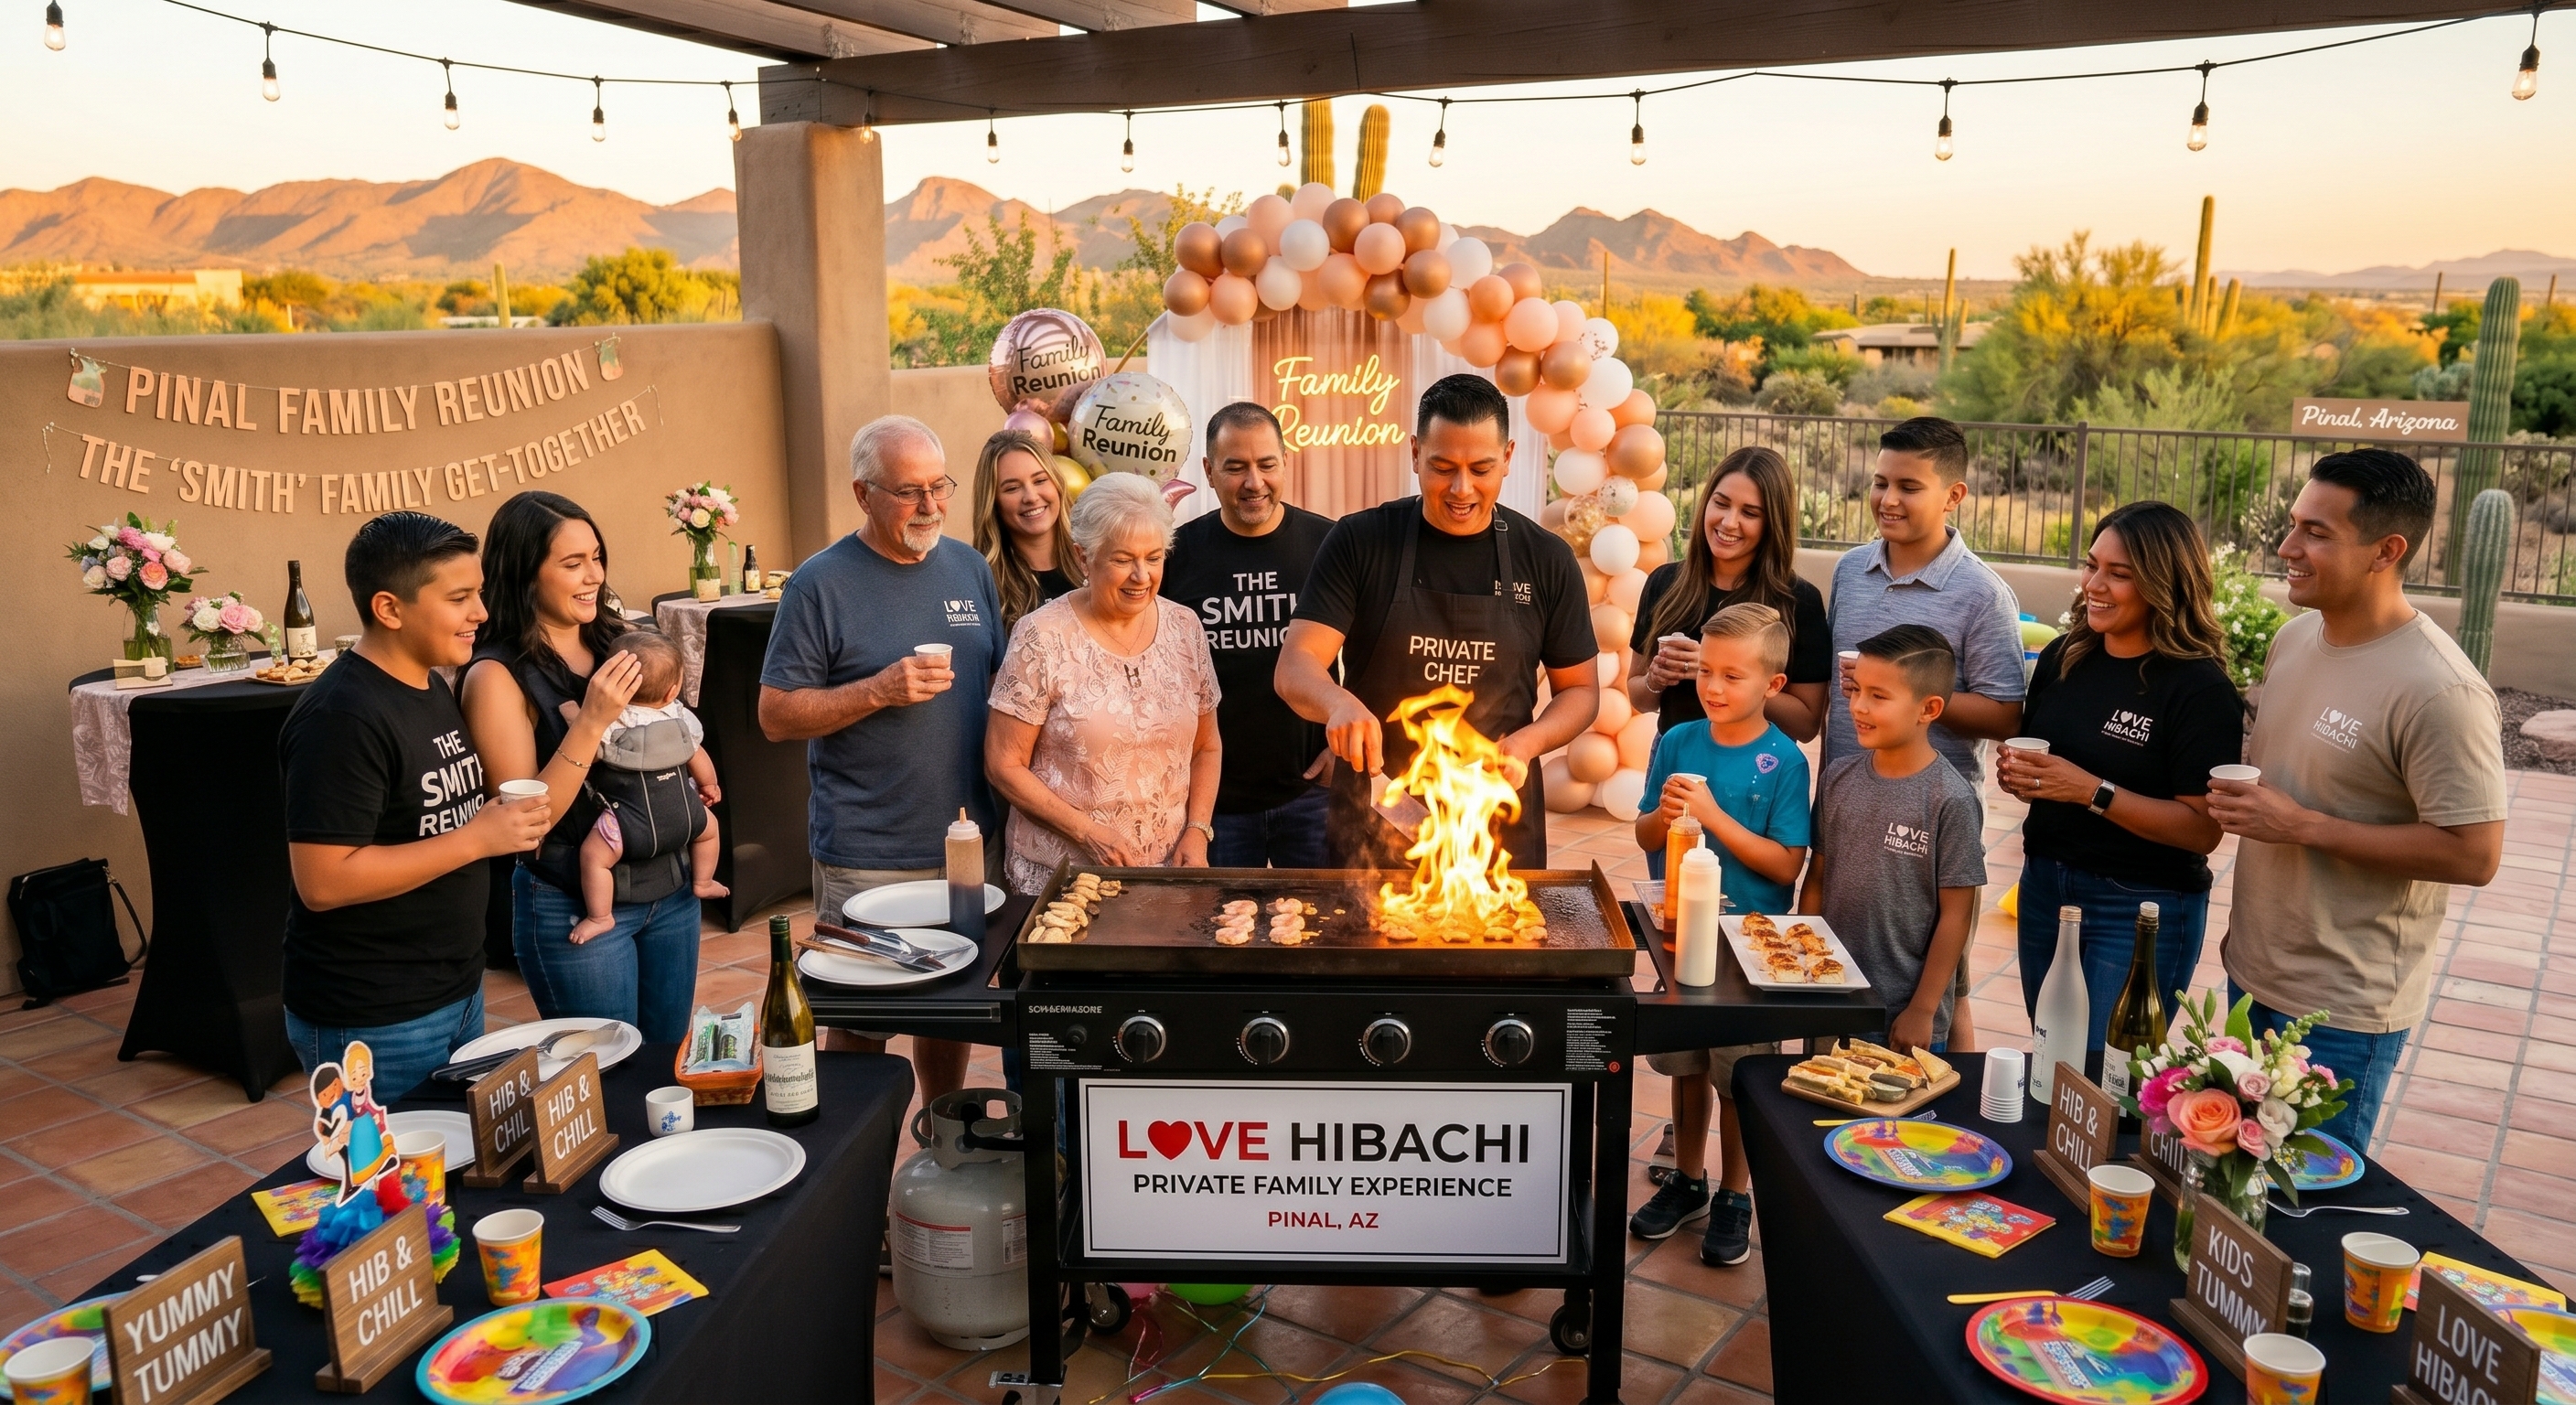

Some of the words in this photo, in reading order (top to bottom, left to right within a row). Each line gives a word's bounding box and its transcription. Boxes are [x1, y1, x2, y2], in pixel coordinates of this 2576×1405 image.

[1017, 335, 1089, 372] Family
[125, 366, 257, 432] PINAL
[278, 384, 419, 434] FAMILY
[435, 349, 591, 426] REUNION
[1013, 365, 1101, 395] Reunion
[1273, 354, 1401, 415] Family
[1082, 428, 1177, 462] Reunion
[1094, 404, 1174, 445] Family
[1271, 403, 1406, 453] Reunion
[2302, 405, 2363, 428] Pinal,
[2369, 408, 2459, 435] Arizona
[79, 434, 156, 494] THE
[321, 467, 433, 514] FAMILY
[445, 400, 647, 501] GET-TOGETHER
[1232, 572, 1278, 592] THE
[1205, 627, 1289, 649] REUNI
[1409, 636, 1496, 660] PRIVATE
[1424, 661, 1480, 684] CHEF
[433, 729, 466, 759] THE
[489, 1080, 516, 1120] HIB
[520, 1069, 531, 1097] &
[548, 1084, 575, 1127] HIB
[579, 1074, 591, 1102] &
[2059, 1083, 2084, 1124] HIB
[2087, 1106, 2098, 1138] &
[495, 1110, 531, 1153] CHIL
[554, 1108, 597, 1160] CHILL
[1291, 1122, 1529, 1164] HIBACHI
[2055, 1122, 2092, 1173] CHILL
[1133, 1174, 1245, 1194] PRIVATE
[1254, 1175, 1343, 1196] FAMILY
[1350, 1177, 1512, 1197] EXPERIENCE
[1268, 1211, 1343, 1229] PINAL,
[1348, 1212, 1379, 1228] AZ
[349, 1249, 391, 1304] HIB
[396, 1236, 413, 1271] &
[2208, 1225, 2254, 1289] KIDS
[123, 1261, 235, 1355] YUMMY
[358, 1278, 423, 1346] CHILL
[134, 1307, 242, 1403] TUMMY
[2437, 1304, 2502, 1385] LOVE
[2415, 1341, 2498, 1405] HIBA
